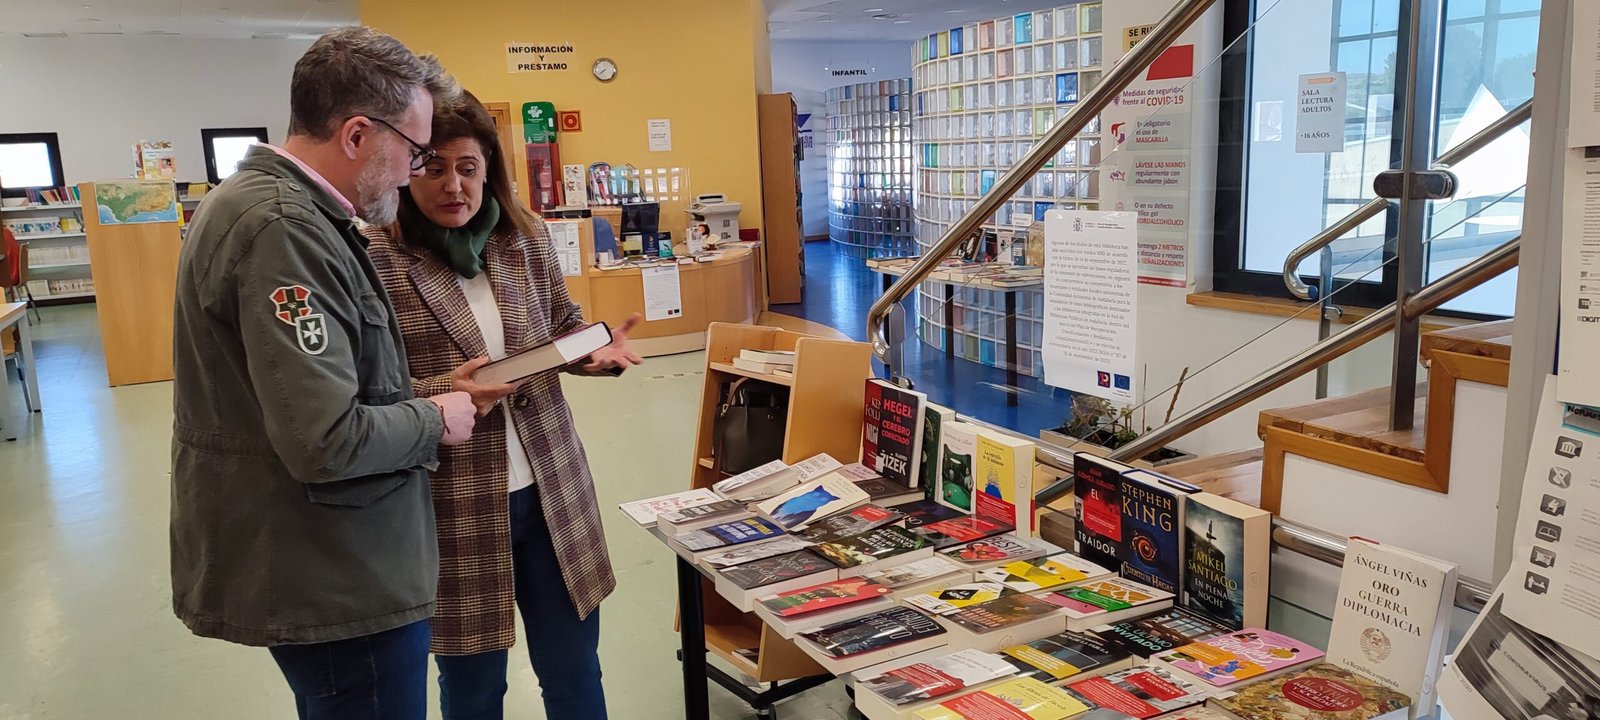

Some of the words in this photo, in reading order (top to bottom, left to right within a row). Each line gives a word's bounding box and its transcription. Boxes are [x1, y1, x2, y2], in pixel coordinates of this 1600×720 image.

[1129, 28, 1138, 37] SE
[508, 45, 573, 54] INFORMACIÓN
[518, 61, 568, 70] PRÉSTAMO
[1141, 258, 1184, 267] SEÑALIZACIONES
[884, 398, 912, 418] HEGEL
[881, 430, 910, 446] CONECTADO
[882, 420, 910, 437] CEREBRO
[1091, 488, 1099, 500] EL
[1122, 482, 1171, 511] STEPHEN
[1122, 496, 1172, 532] KING
[1078, 530, 1116, 557] TRAIDOR
[1196, 552, 1225, 573] MIKEL
[1354, 554, 1390, 576] ÁNGEL
[1392, 570, 1428, 588] VIÑAS
[1188, 560, 1238, 592] SANTIAGO
[1195, 578, 1204, 588] EN
[1206, 583, 1228, 600] PLENA
[1372, 580, 1400, 597] ORO
[1198, 591, 1223, 608] NOCHE
[1358, 590, 1408, 616] GUERRA
[892, 611, 940, 633] FRAUDE
[1119, 622, 1133, 630] EL
[1343, 598, 1421, 637] DIPLOMACIA
[1351, 660, 1376, 678] República
[1376, 672, 1400, 688] española
[1503, 651, 1547, 692] CORONAVIRUS
